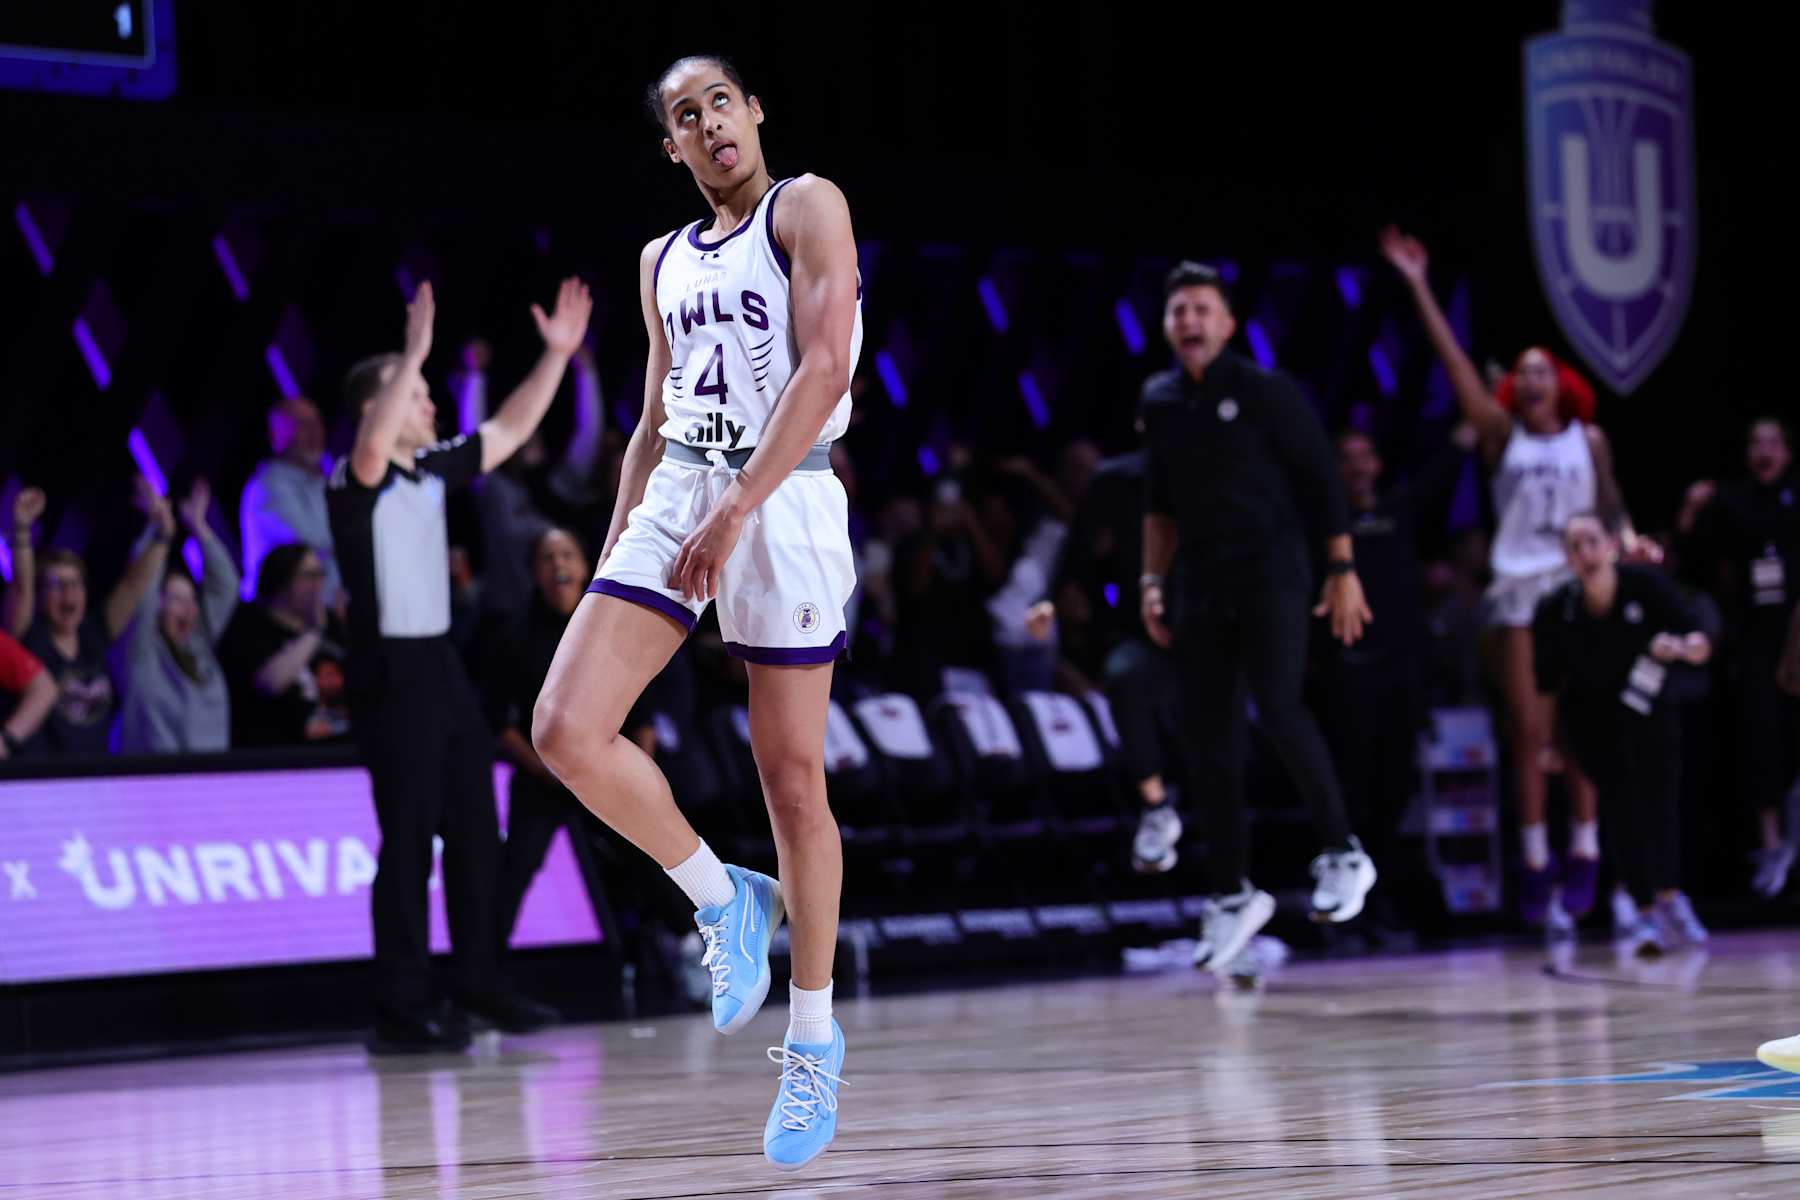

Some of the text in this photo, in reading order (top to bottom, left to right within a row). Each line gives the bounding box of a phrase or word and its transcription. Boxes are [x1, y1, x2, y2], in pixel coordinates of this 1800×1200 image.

[1560, 131, 1661, 298] U
[694, 343, 728, 405] 4
[60, 831, 378, 908] UNRIVA
